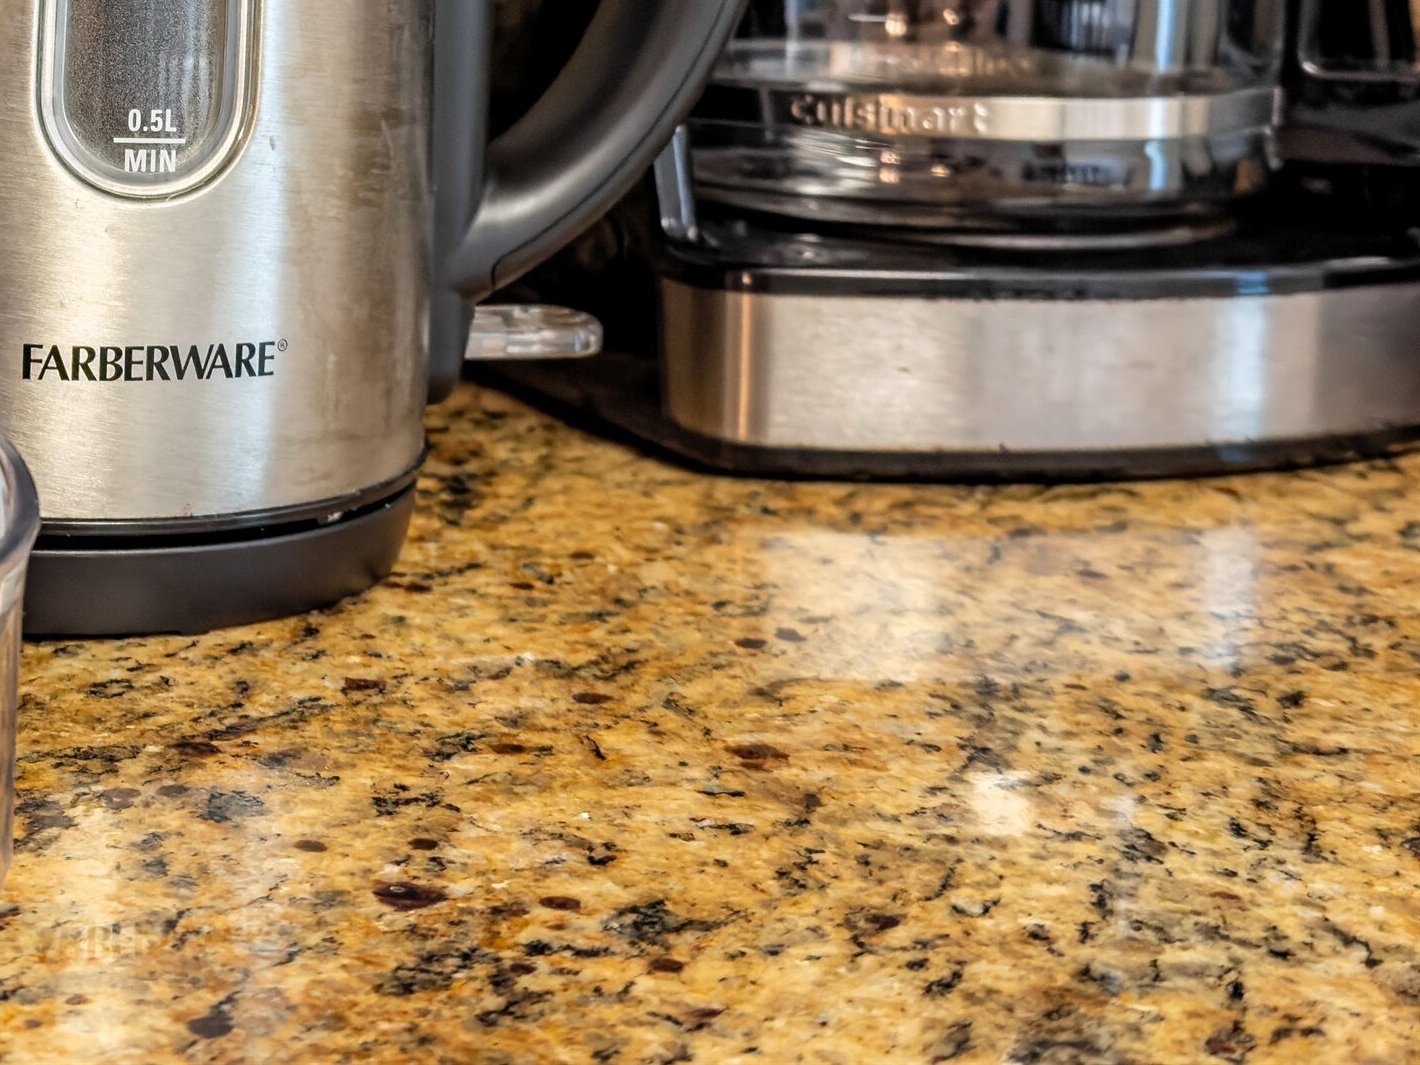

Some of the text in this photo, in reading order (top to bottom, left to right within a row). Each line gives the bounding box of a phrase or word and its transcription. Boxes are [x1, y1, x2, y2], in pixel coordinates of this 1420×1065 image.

[127, 109, 177, 133] 0.5L
[124, 149, 178, 172] MIN
[21, 341, 276, 382] FARBERWARE
